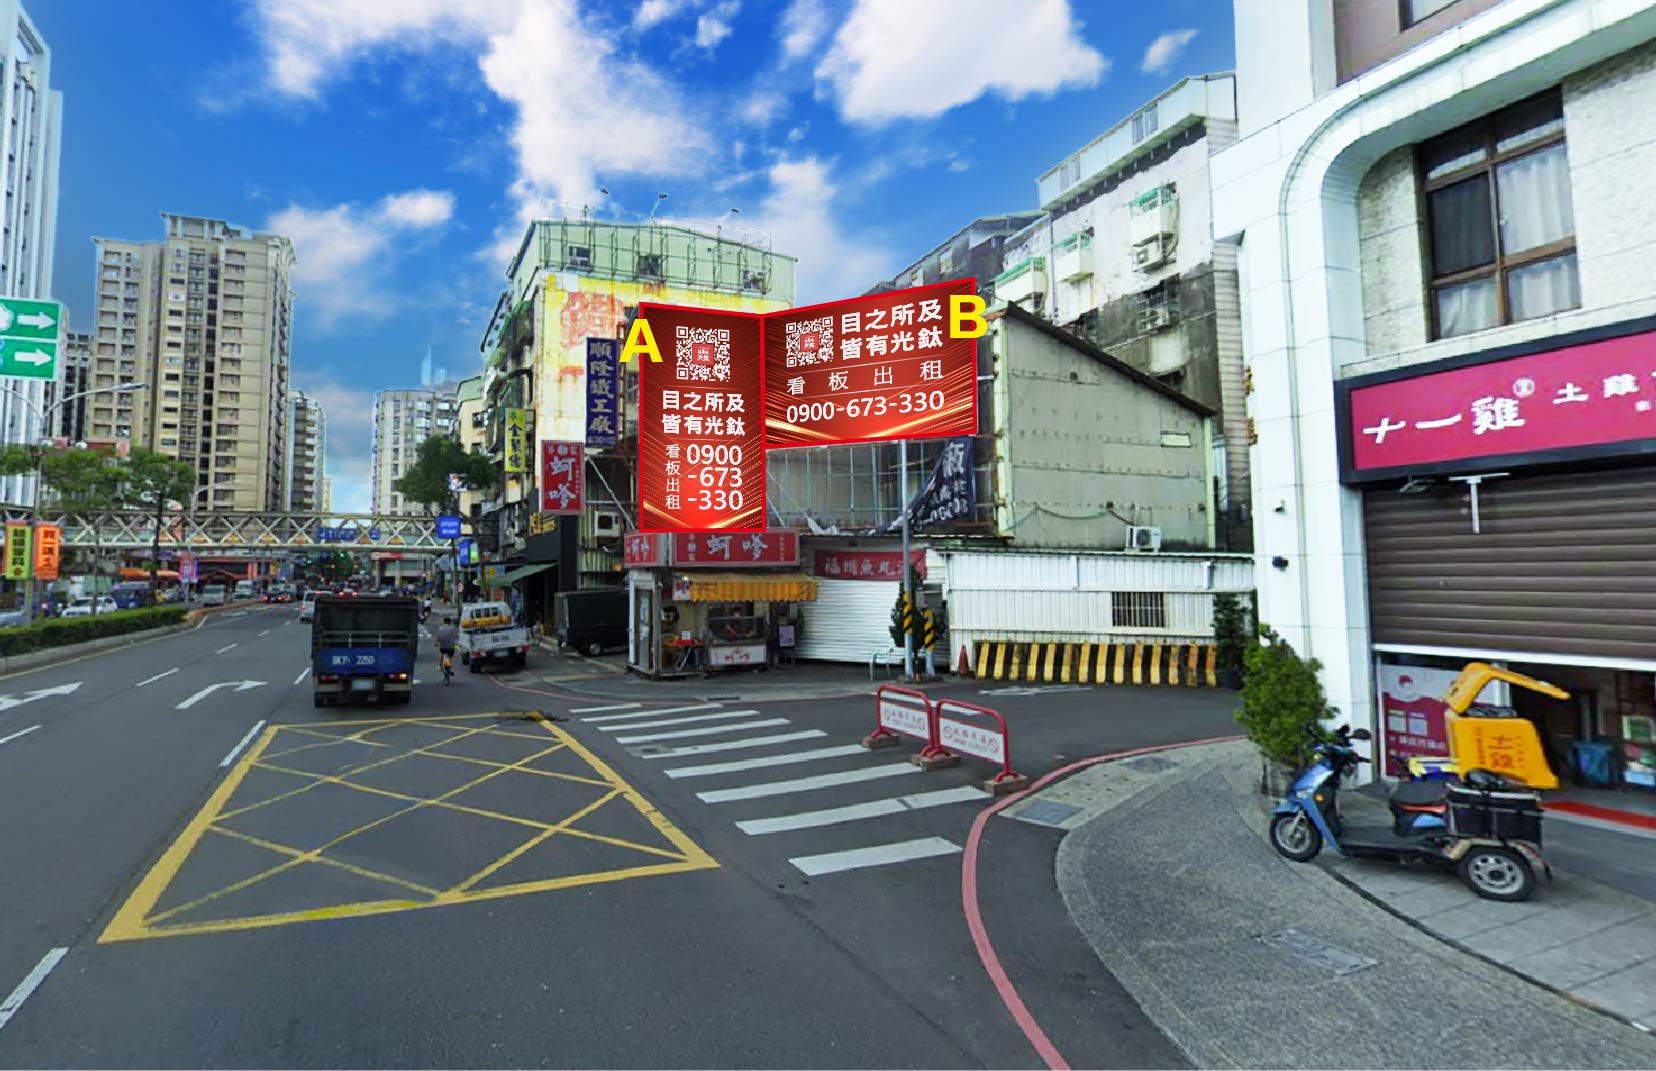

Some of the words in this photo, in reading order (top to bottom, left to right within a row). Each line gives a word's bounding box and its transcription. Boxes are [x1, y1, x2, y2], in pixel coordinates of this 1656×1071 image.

[841, 298, 943, 334] 目之所及
[840, 327, 943, 361] 皆有光鈦
[786, 359, 944, 396] 看板出租
[662, 390, 745, 411] 目之所及
[786, 390, 945, 424] 0900-673-330
[661, 414, 745, 436] 皆有光鈦
[1363, 396, 1525, 443] 十一雞
[686, 444, 742, 466] 0900
[665, 444, 681, 510] 看板出租
[687, 466, 743, 487] -673
[687, 489, 743, 510] -330
